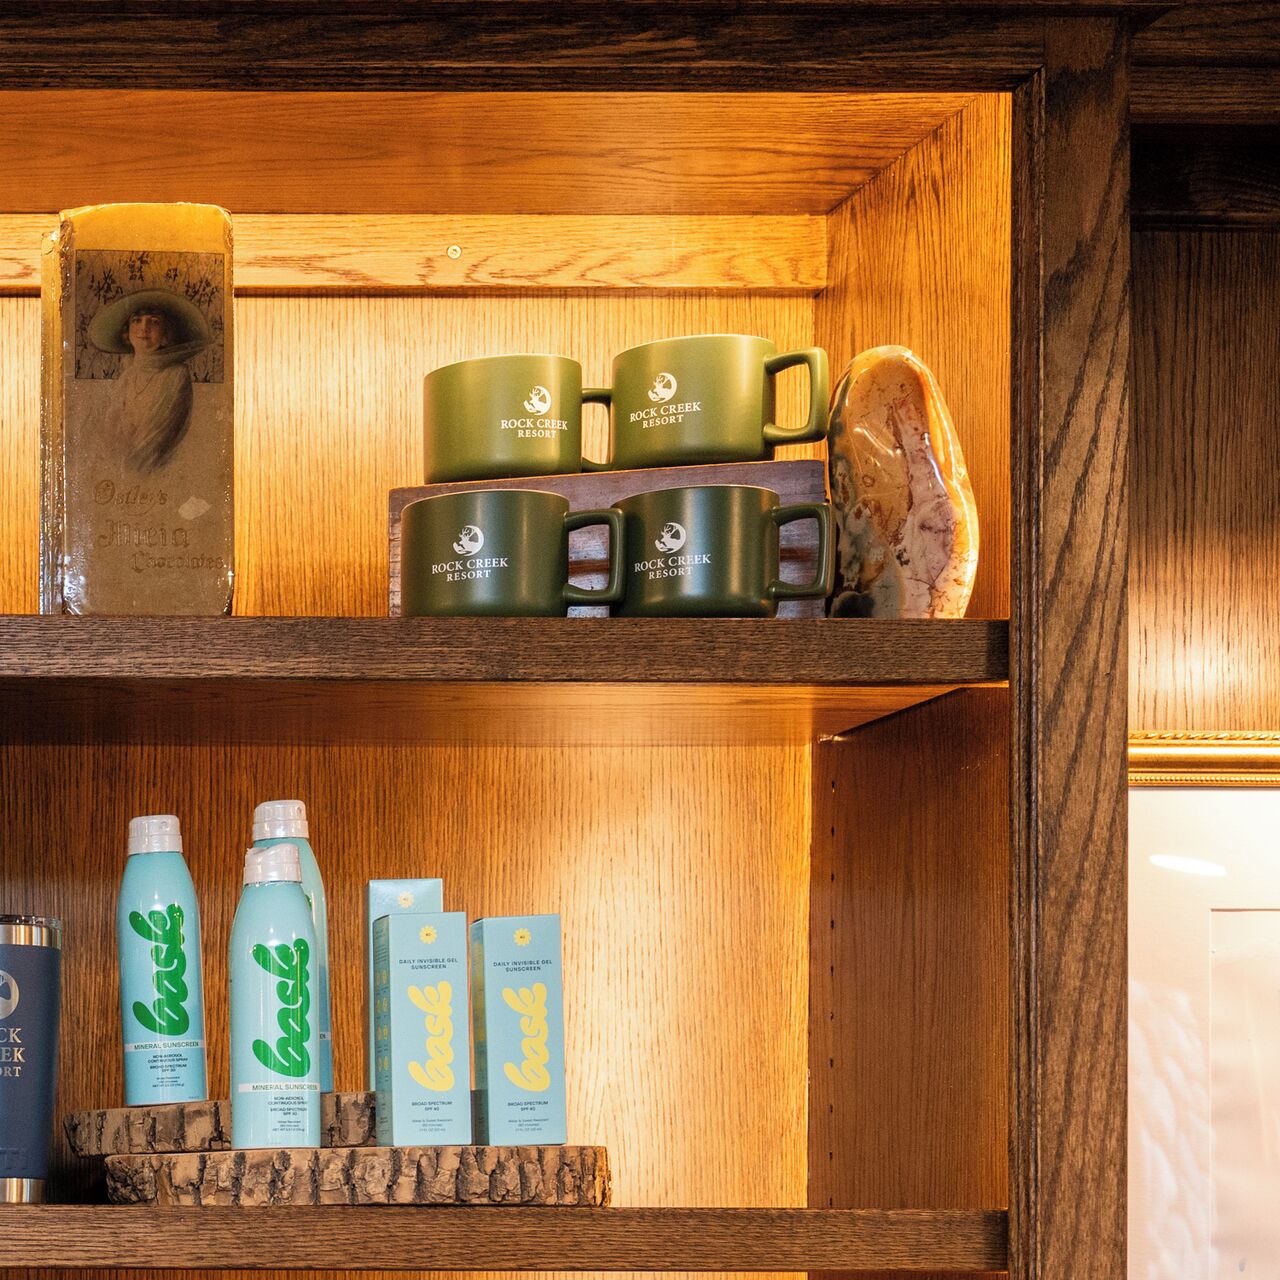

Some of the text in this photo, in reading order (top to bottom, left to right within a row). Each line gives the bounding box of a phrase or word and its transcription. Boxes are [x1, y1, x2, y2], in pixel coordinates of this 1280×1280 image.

[630, 401, 702, 422] ROCK CREEK
[501, 418, 568, 431] ROCK CREEK
[642, 414, 684, 429] RESORT
[518, 429, 556, 438] RESORT
[432, 557, 508, 574] ROCK CREEK
[634, 554, 711, 573] ROCK CREEK
[446, 570, 492, 581] RESORT
[648, 566, 694, 580] RESORT
[129, 904, 189, 1036] bask
[252, 938, 310, 1077] bask
[407, 981, 455, 1092] bask
[502, 982, 551, 1092] bask
